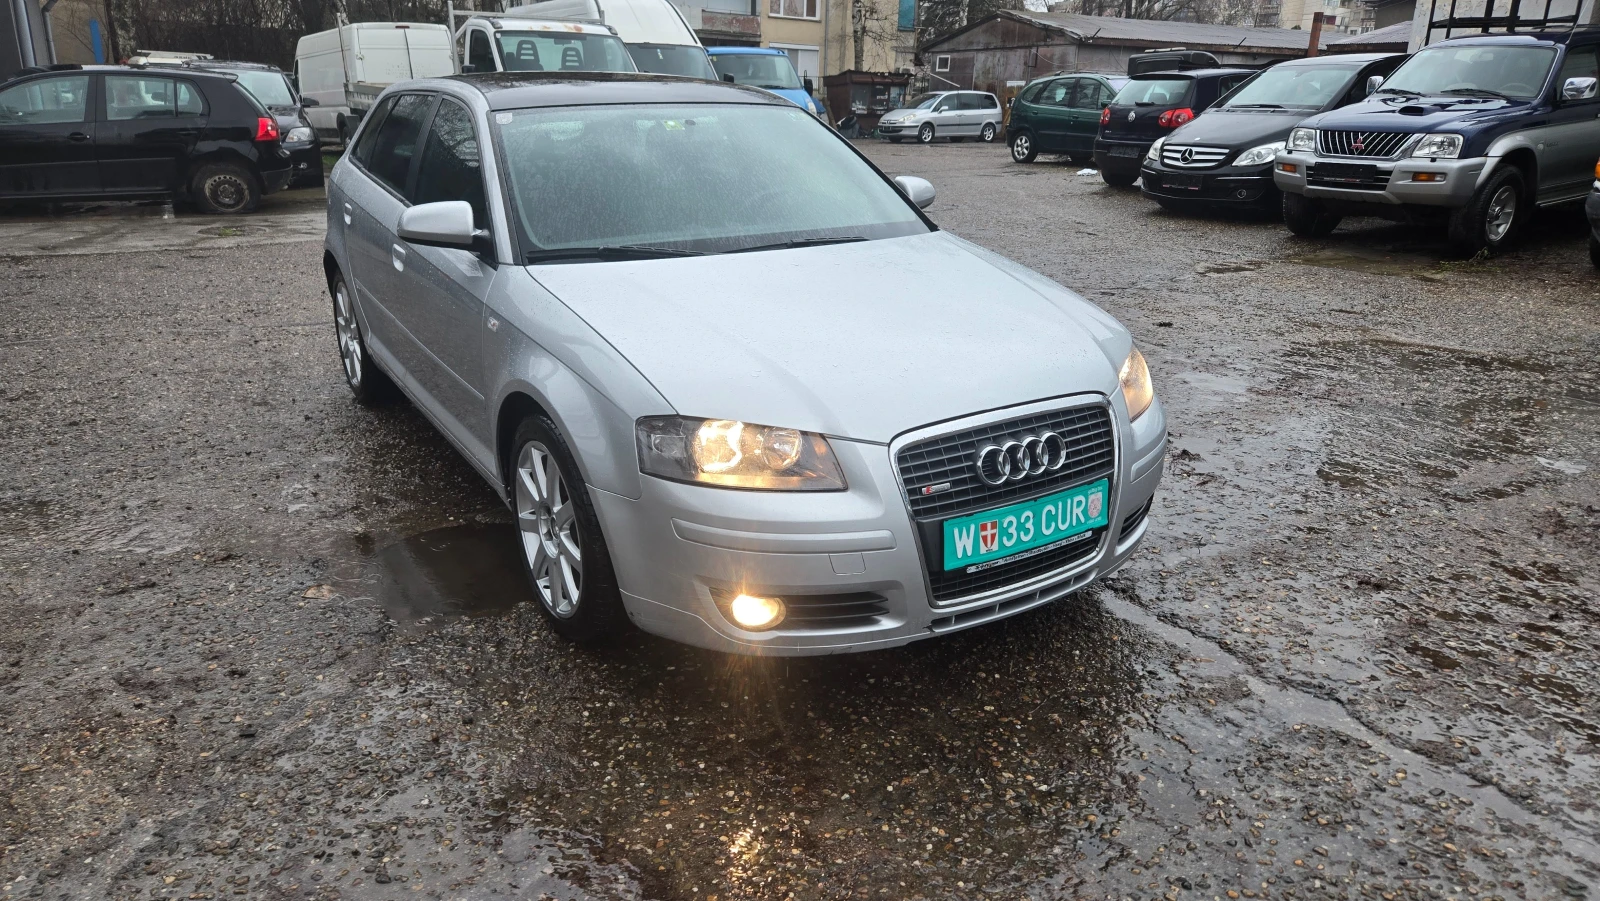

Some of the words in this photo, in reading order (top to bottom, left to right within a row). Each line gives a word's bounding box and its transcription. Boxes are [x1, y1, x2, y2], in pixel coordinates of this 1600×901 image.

[953, 523, 975, 559] W
[1002, 510, 1035, 547] 33
[1041, 494, 1086, 536] CUR
